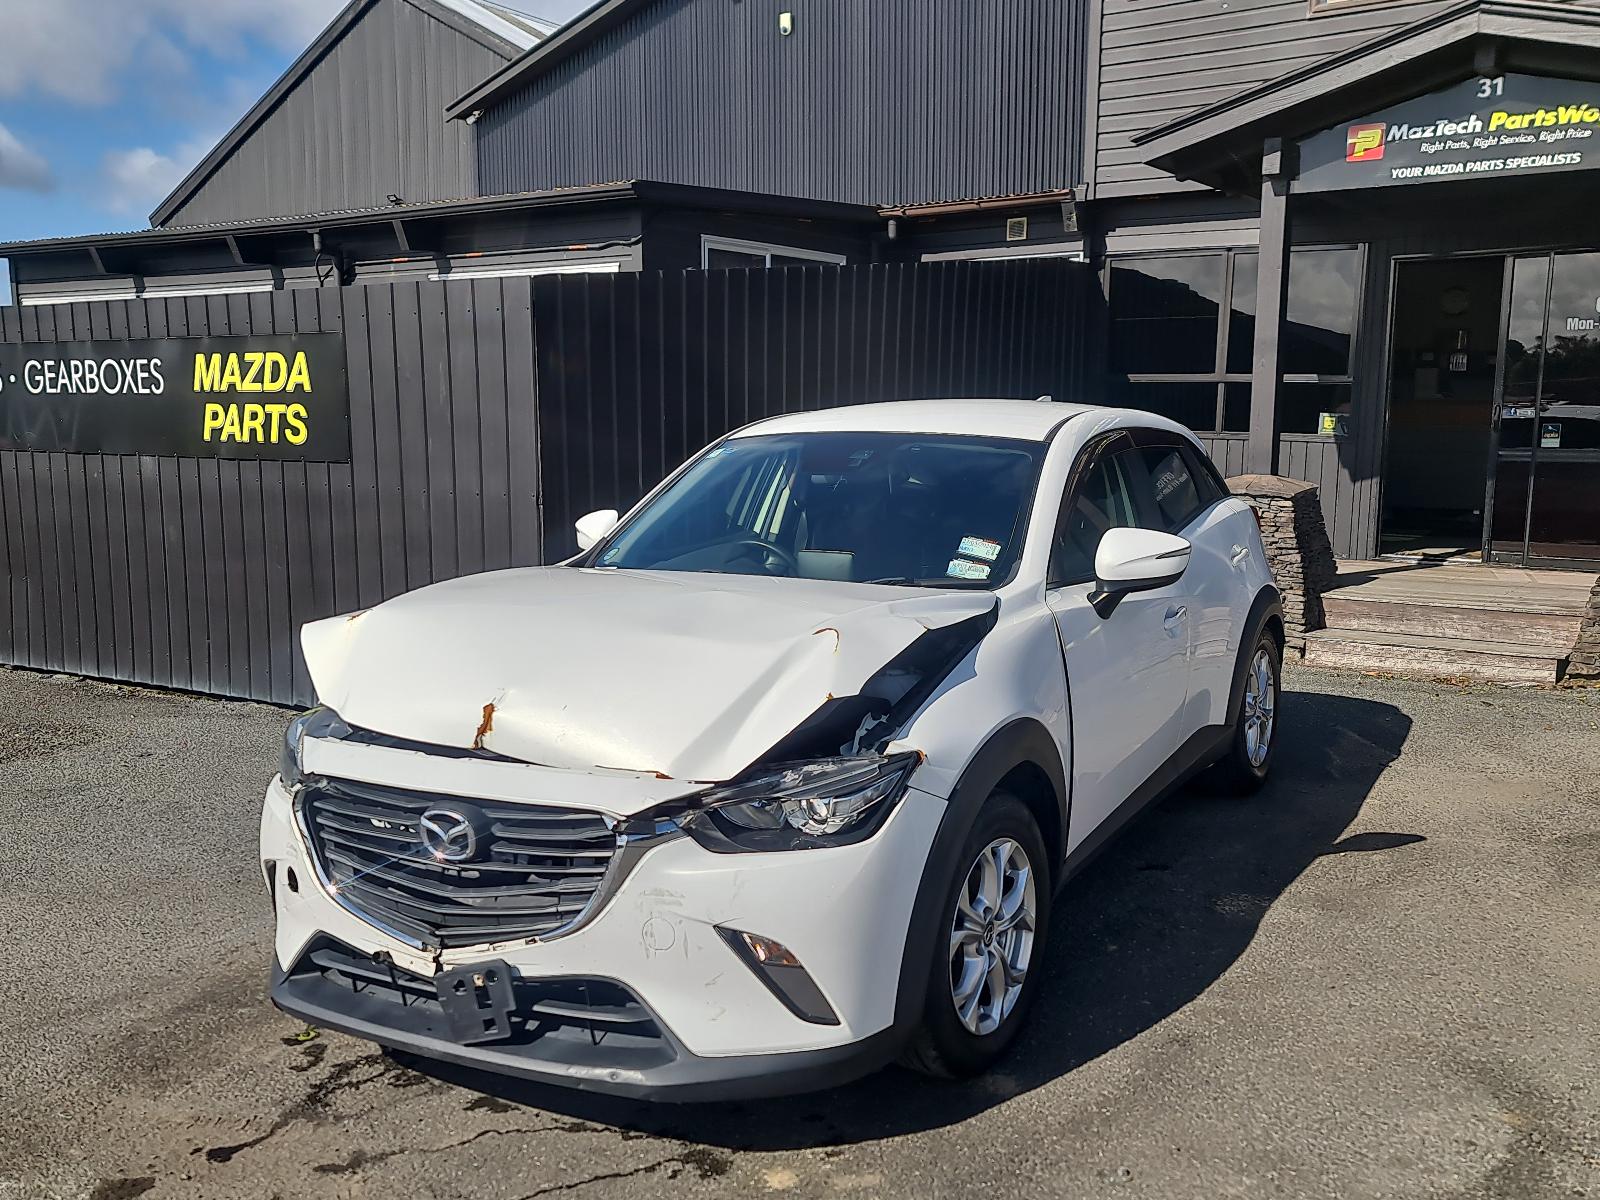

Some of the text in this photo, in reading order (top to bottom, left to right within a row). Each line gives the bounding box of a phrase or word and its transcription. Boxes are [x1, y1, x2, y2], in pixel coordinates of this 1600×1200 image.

[1476, 77, 1505, 98] 31
[1387, 103, 1600, 141] MazTech PartsWo
[1420, 127, 1593, 153] Right Parts, Right Service, Right Price
[1391, 152, 1582, 179] YOUR MAZDA PARTS SPECIALISTS
[1566, 317, 1600, 331] Mon-
[24, 358, 165, 395] GEARBOXES
[193, 351, 313, 394] MAZDA
[203, 403, 309, 446] PARTS
